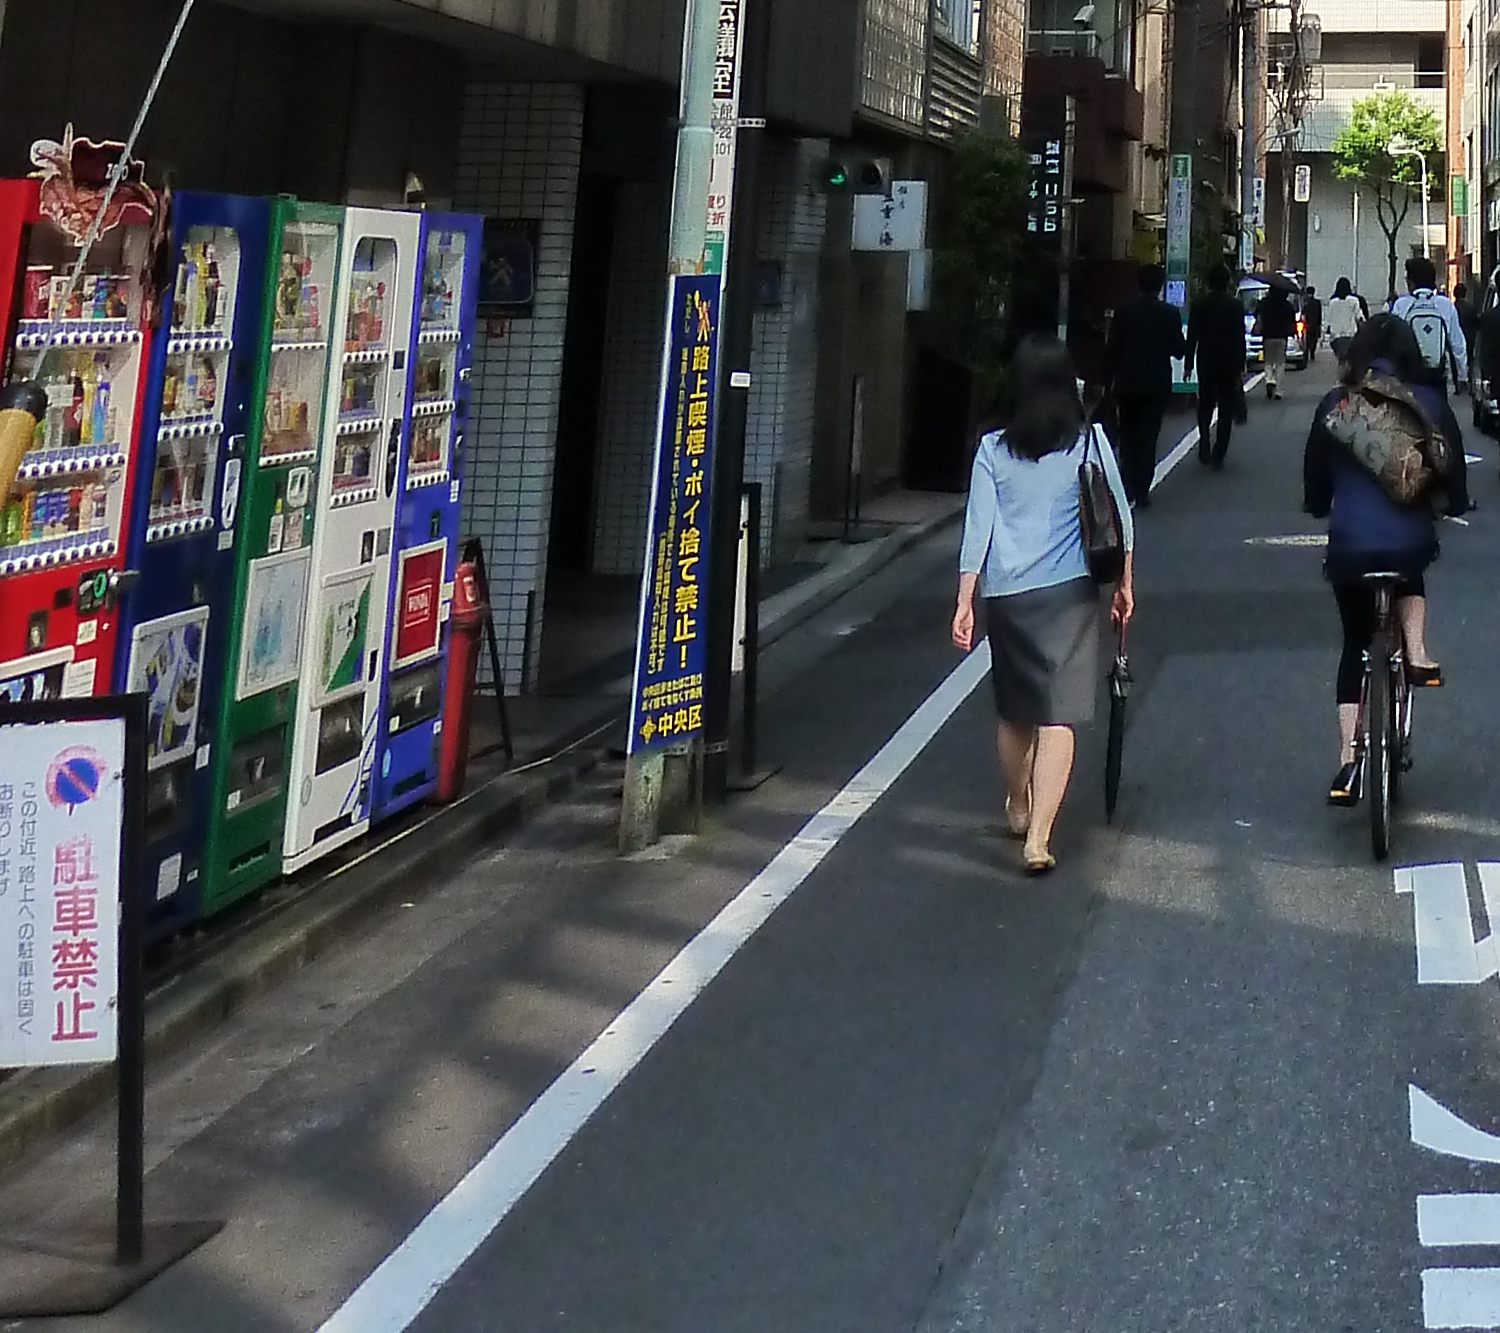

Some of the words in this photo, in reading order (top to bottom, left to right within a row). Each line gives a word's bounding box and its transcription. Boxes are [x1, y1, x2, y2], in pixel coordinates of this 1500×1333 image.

[657, 704, 702, 738] 中央区
[51, 834, 98, 1042] 駐車禁止
